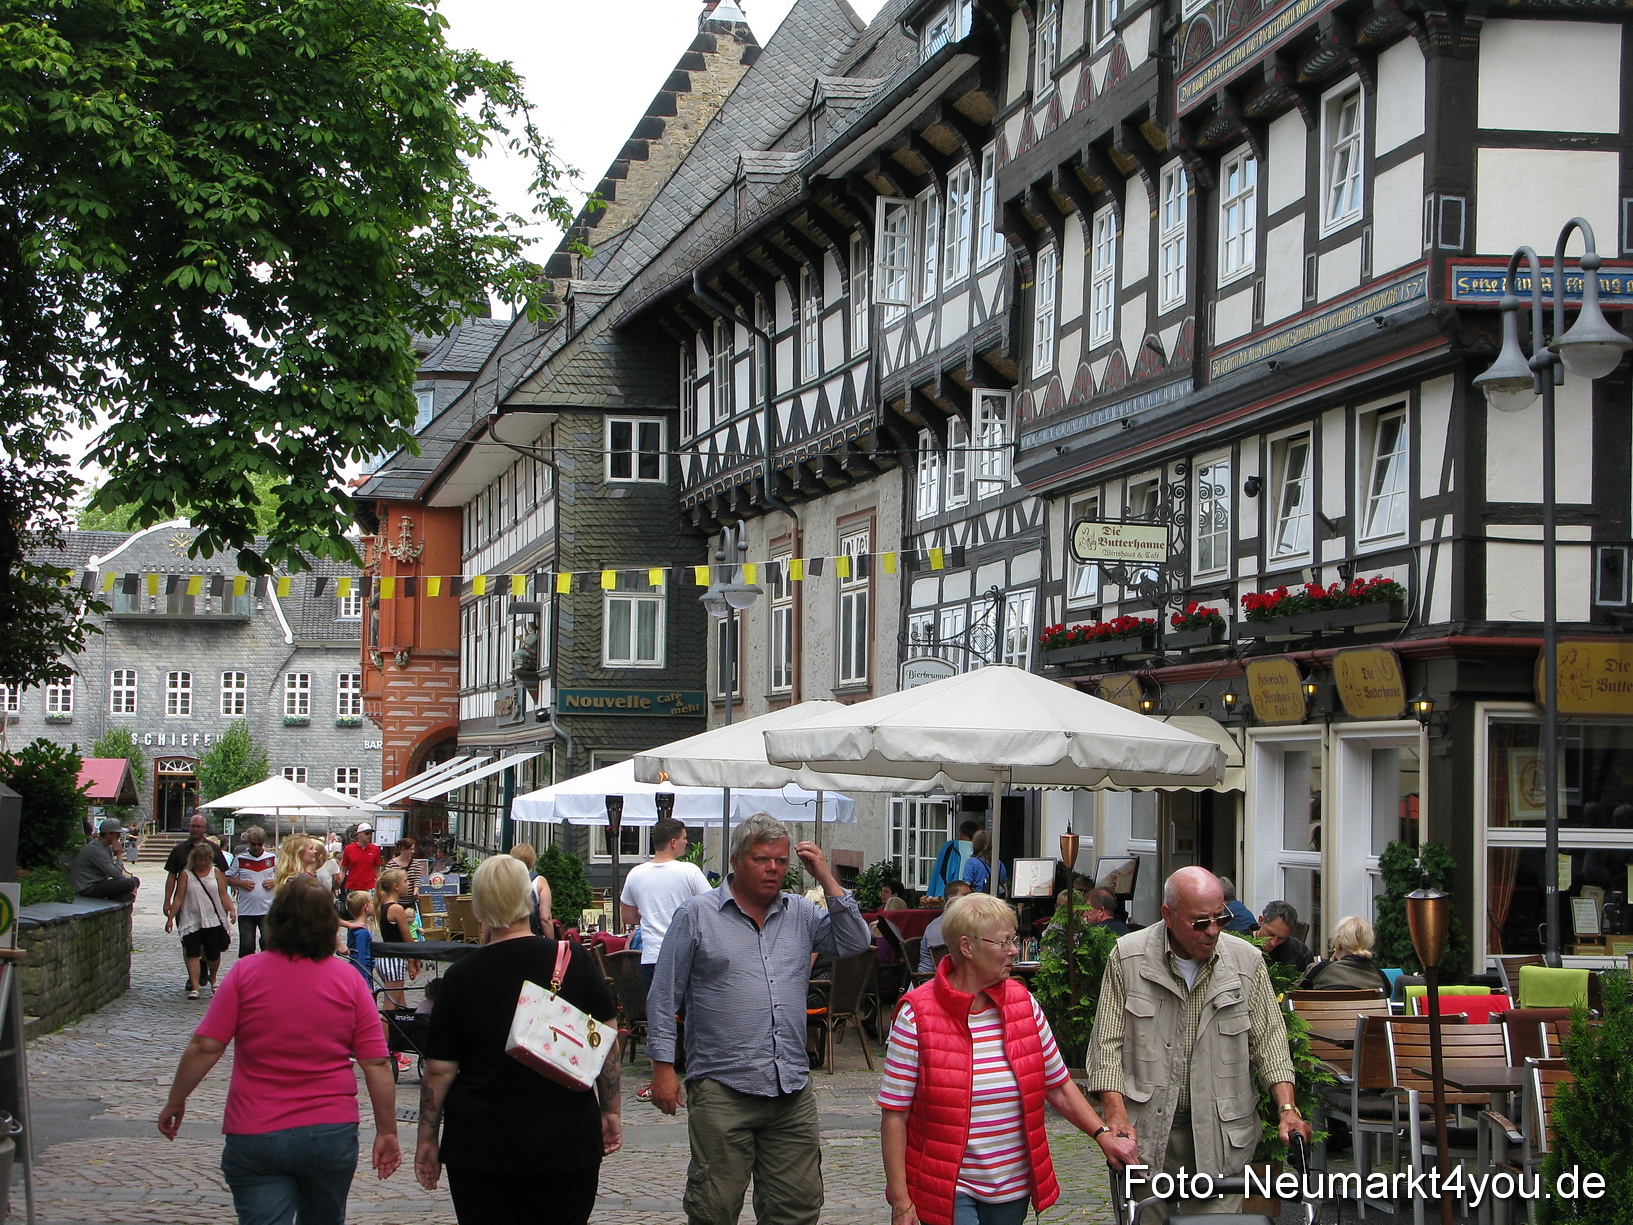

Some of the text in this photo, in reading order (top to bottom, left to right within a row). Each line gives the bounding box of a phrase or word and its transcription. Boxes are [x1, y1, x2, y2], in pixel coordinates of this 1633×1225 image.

[1101, 526, 1123, 536] Die
[1097, 536, 1165, 549] Butterhanne
[1604, 657, 1631, 673] Die
[566, 694, 652, 709] Nouvelle
[670, 703, 701, 715] mehr
[364, 740, 383, 750] BAR
